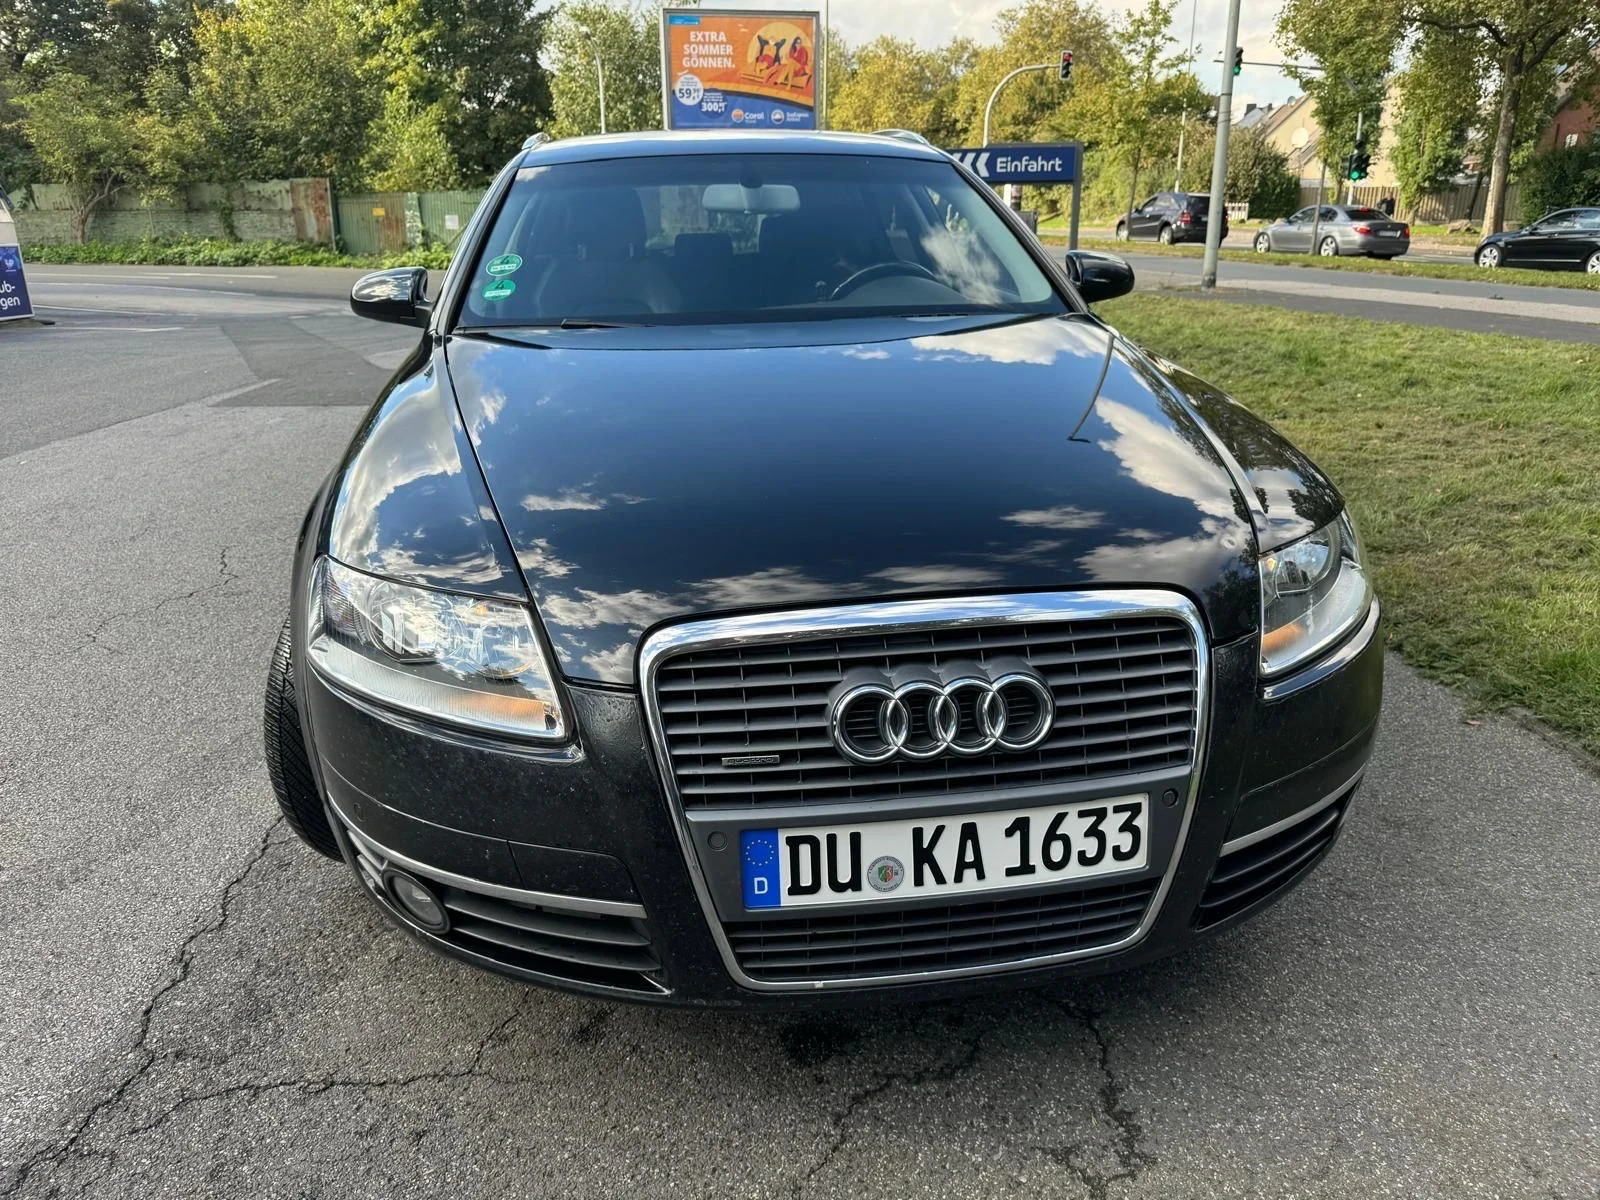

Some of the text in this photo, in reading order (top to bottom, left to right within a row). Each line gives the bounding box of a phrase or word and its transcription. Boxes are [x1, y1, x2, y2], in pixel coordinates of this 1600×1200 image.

[690, 31, 727, 42] EXTRA
[683, 44, 734, 56] SOMMER
[682, 55, 736, 69] GÖNNEN.
[996, 155, 1063, 173] Einfahrt
[785, 831, 863, 896] DU
[912, 822, 986, 887] KA
[1004, 802, 1142, 877] 1633
[753, 877, 769, 895] D
